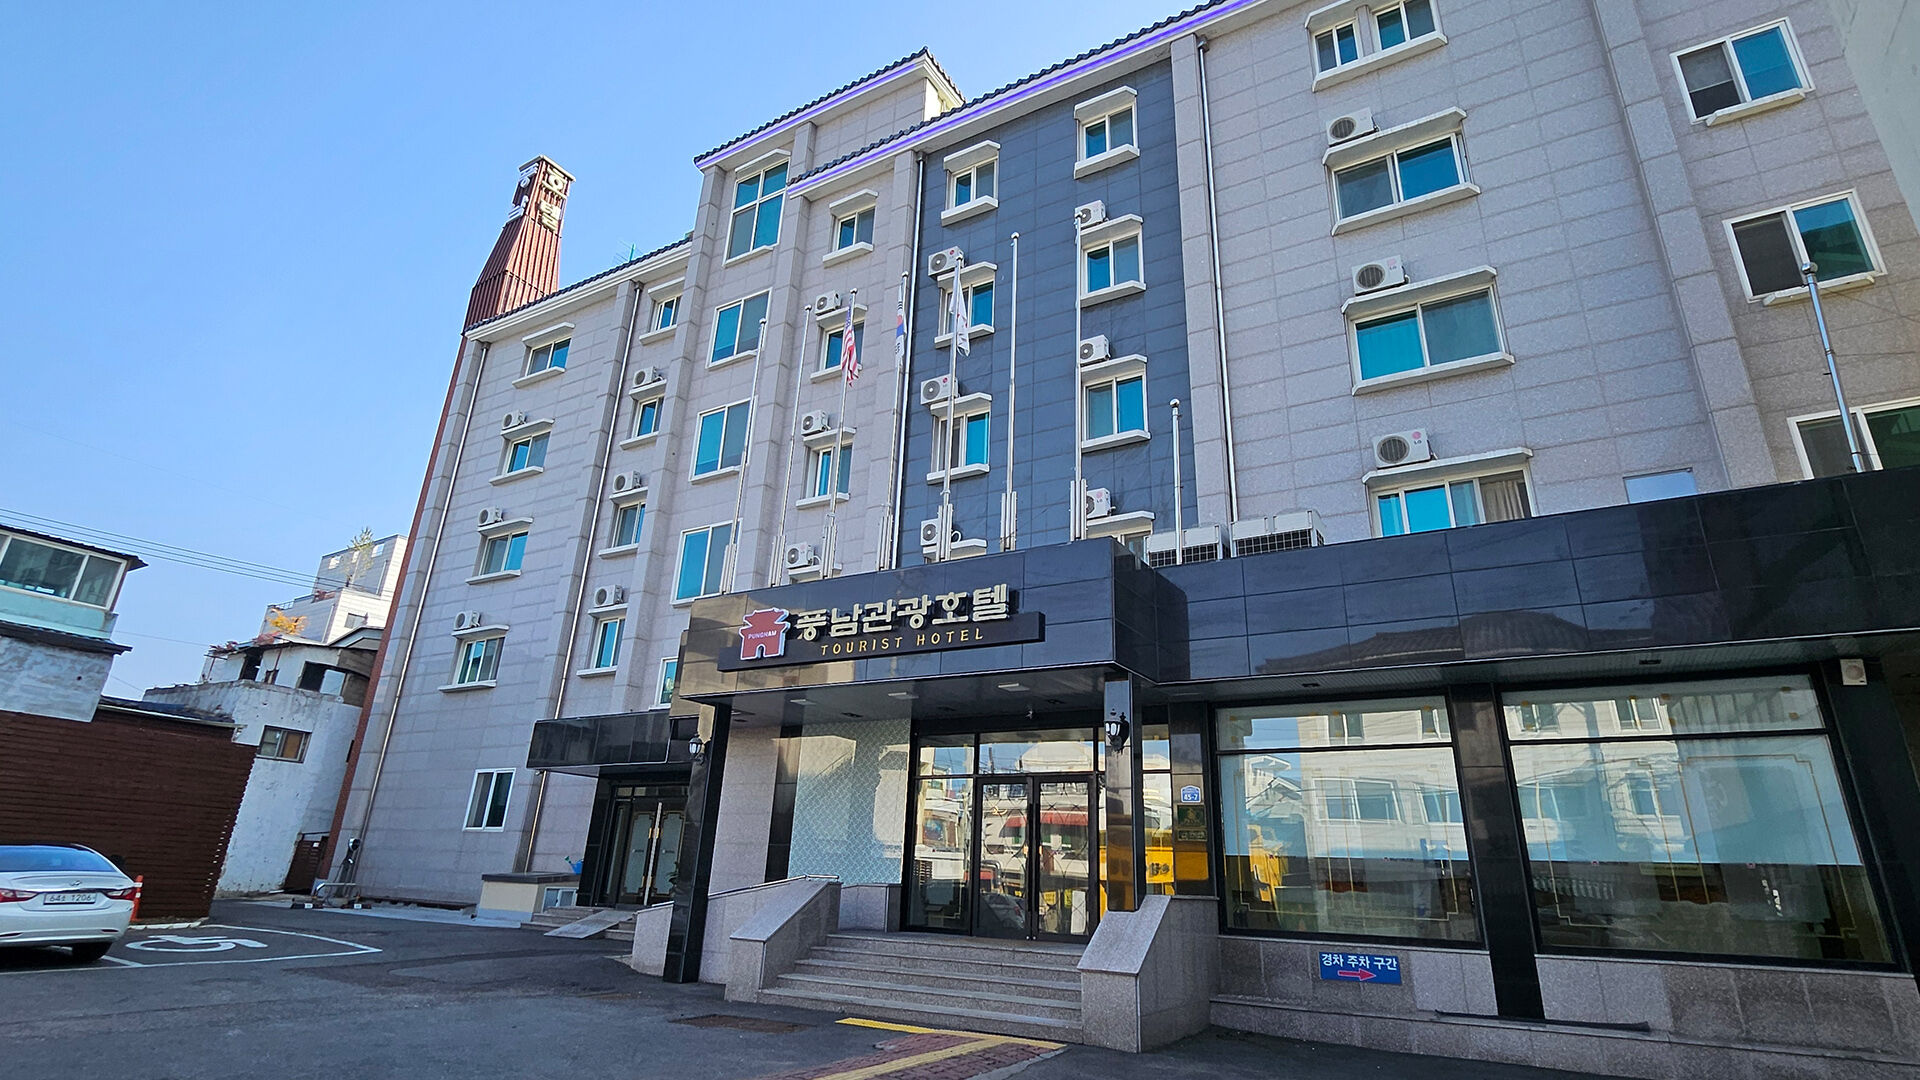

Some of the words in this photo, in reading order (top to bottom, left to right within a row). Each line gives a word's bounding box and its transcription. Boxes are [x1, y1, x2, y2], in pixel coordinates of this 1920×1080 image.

[540, 164, 568, 231] 호텔
[795, 583, 1010, 641] 풍남관광호텔
[748, 630, 777, 640] PUNGNAM
[821, 636, 903, 656] TOURIST
[917, 628, 984, 646] HOTEL
[1184, 793, 1198, 801] 45-7
[1321, 953, 1344, 967] 경차
[1347, 955, 1370, 969] 주차
[1373, 957, 1398, 971] 구간
